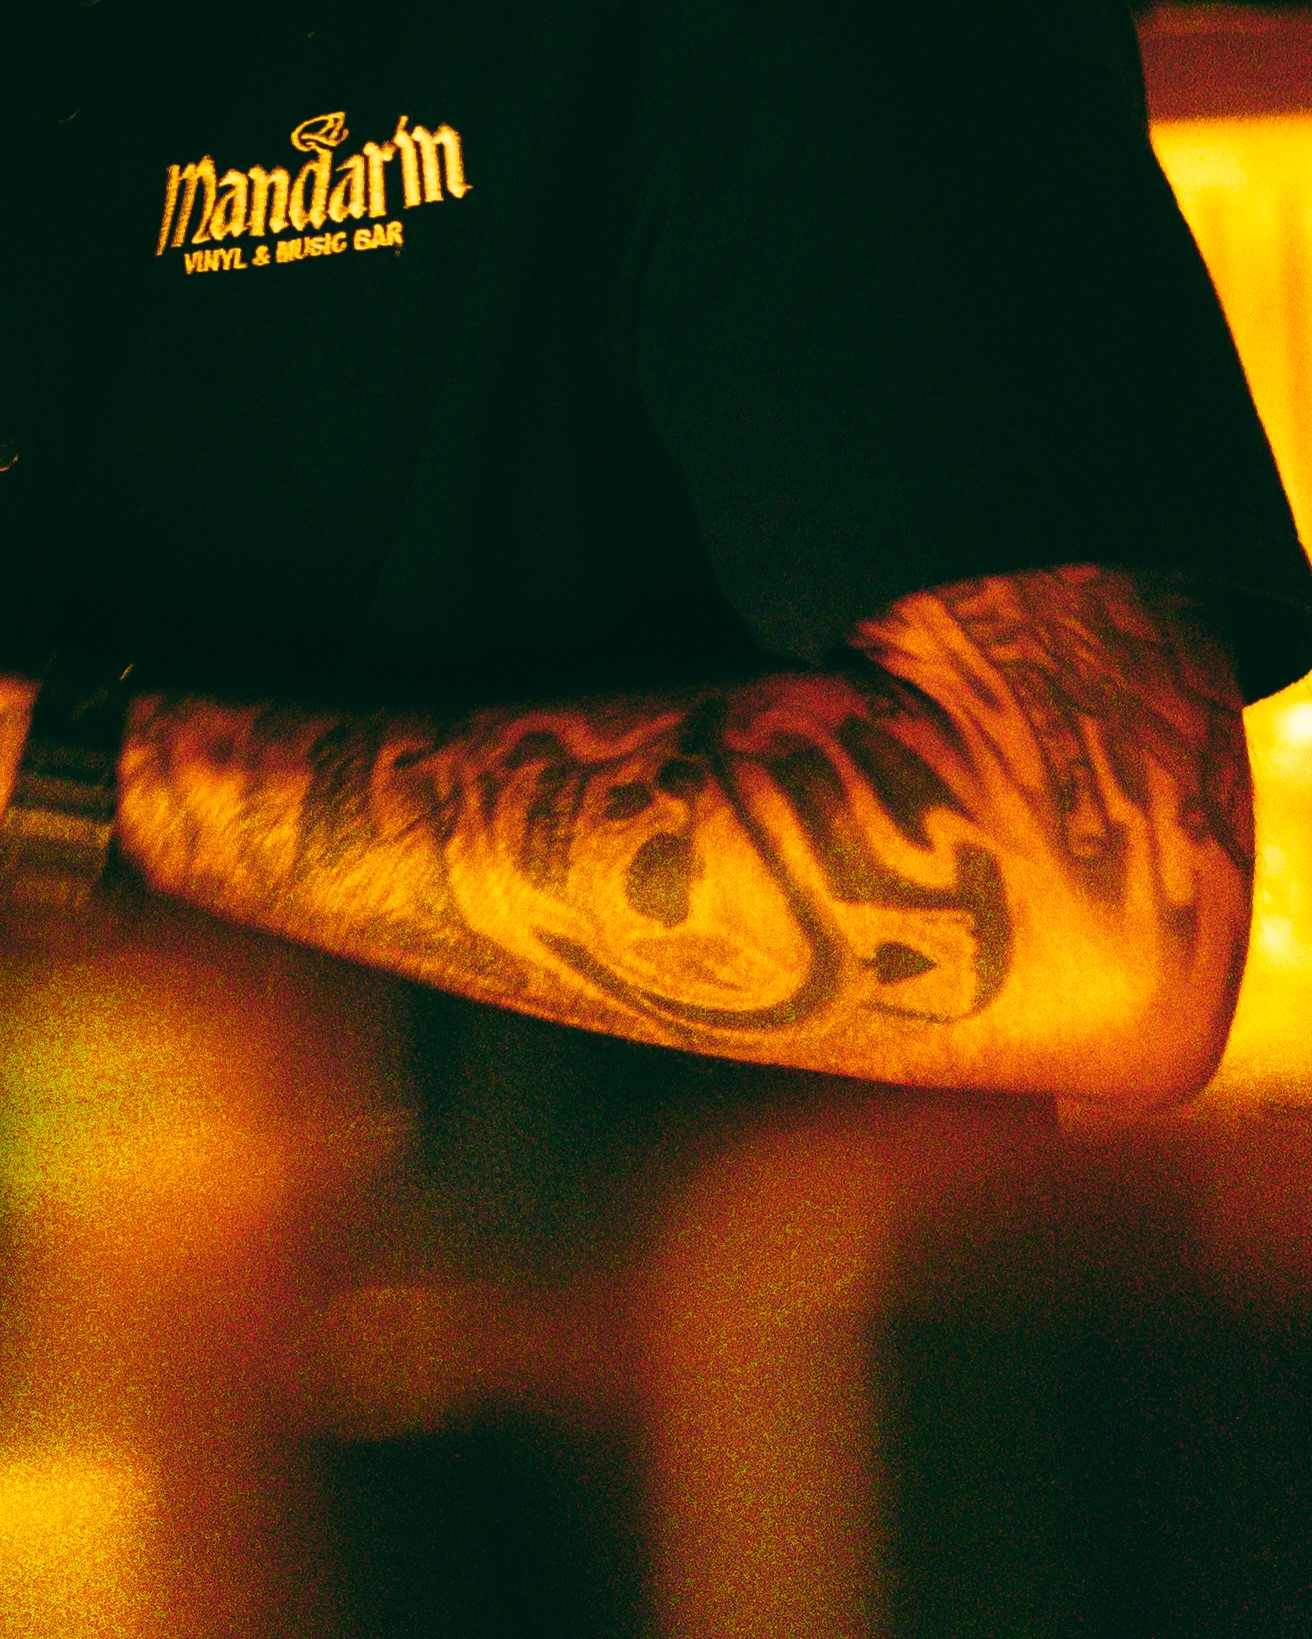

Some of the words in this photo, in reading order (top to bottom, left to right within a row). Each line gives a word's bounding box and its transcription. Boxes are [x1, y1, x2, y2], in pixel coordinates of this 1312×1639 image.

[155, 112, 473, 257] Mandarin
[184, 248, 248, 275] VINYL
[252, 245, 270, 266] &
[276, 231, 348, 263] MUSIC
[353, 221, 403, 251] BAR
